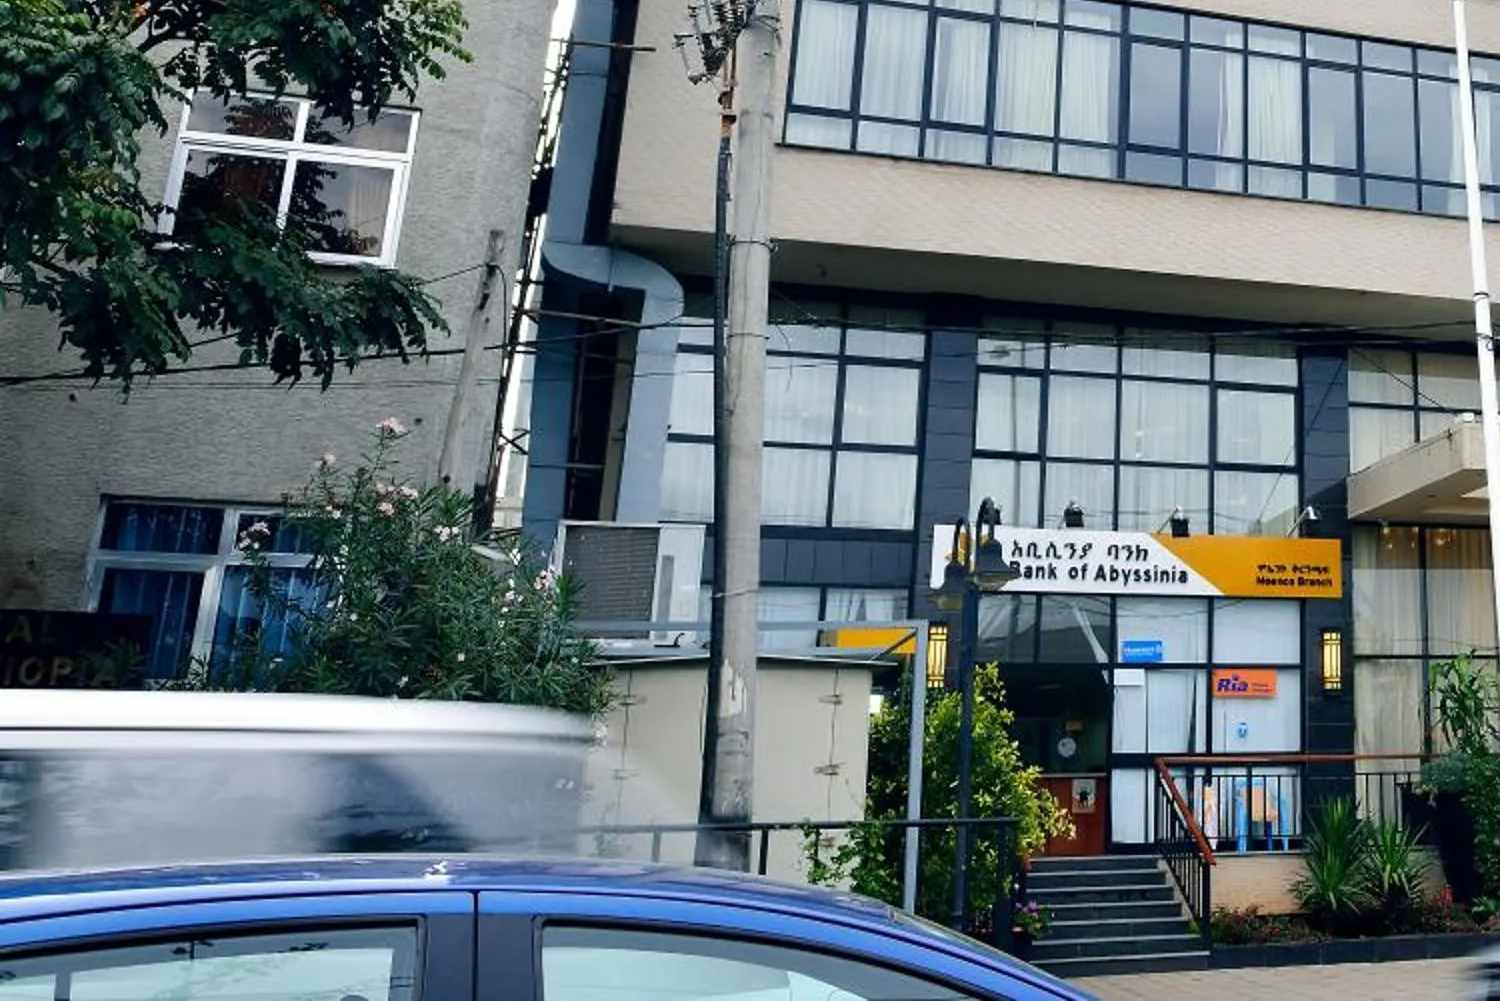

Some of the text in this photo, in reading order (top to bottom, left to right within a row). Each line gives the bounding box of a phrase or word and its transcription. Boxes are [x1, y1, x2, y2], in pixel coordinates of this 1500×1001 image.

[1107, 544, 1149, 561] ባንክ
[1068, 563, 1088, 580] of
[1094, 563, 1188, 586] Abyssinia
[1216, 674, 1249, 692] Ria
